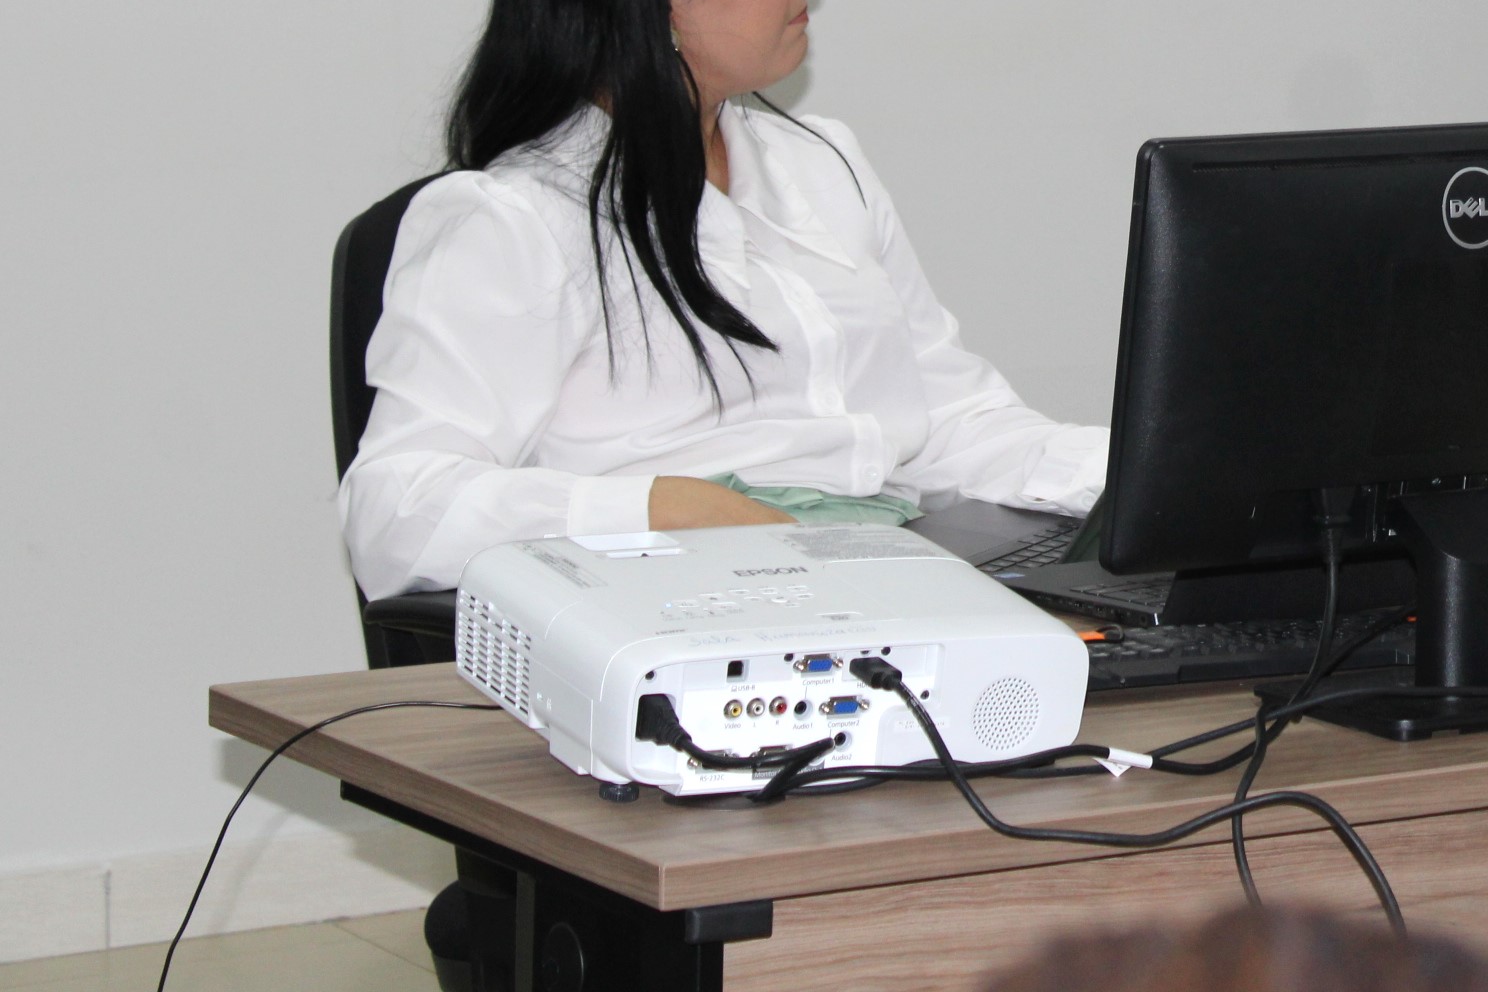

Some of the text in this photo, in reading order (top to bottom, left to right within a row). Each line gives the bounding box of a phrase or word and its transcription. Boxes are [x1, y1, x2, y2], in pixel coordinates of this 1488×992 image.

[732, 566, 808, 577] EPSON
[802, 677, 835, 687] Computer1
[792, 722, 813, 730] Audio1
[827, 719, 860, 728] Computer2
[831, 753, 852, 761] Audio2
[699, 774, 724, 782] RS-232C
